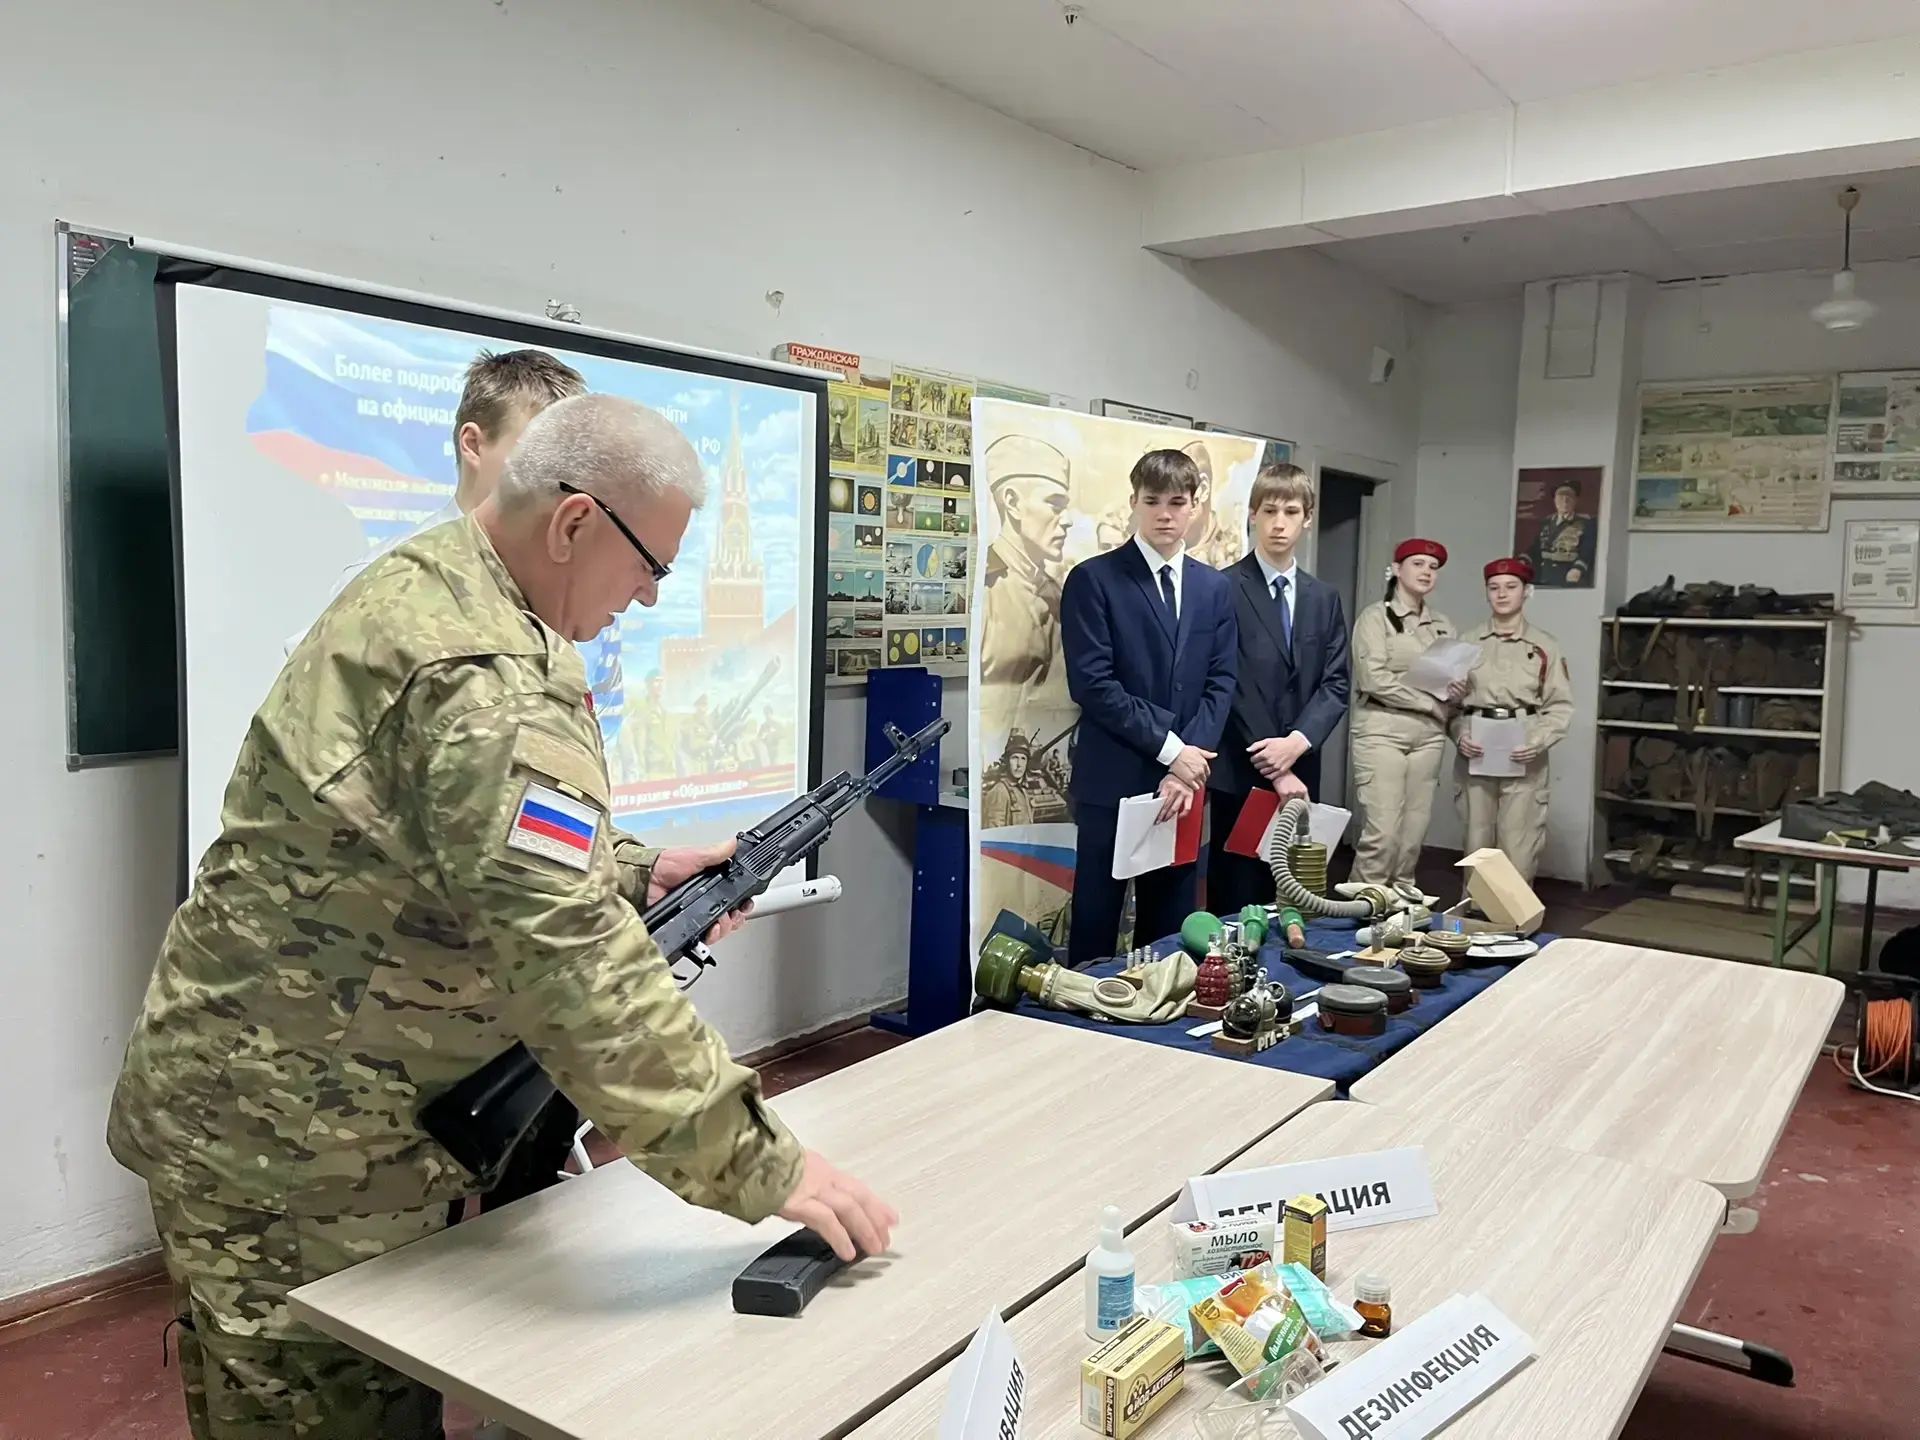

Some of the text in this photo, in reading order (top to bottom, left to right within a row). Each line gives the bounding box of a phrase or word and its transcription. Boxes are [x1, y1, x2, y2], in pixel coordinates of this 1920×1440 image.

[791, 345, 859, 367] ГРАЖДАНСКАЯ
[334, 354, 465, 395] Более подроб
[357, 397, 379, 416] на
[701, 435, 721, 456] РФ
[1217, 1181, 1392, 1224] ГАЦИЯ
[1211, 1230, 1259, 1247] МЫЛО
[1338, 1323, 1500, 1440] ДЕЗИНФЕКЦИЯ
[998, 1357, 1025, 1440] ВАЦИЯ
